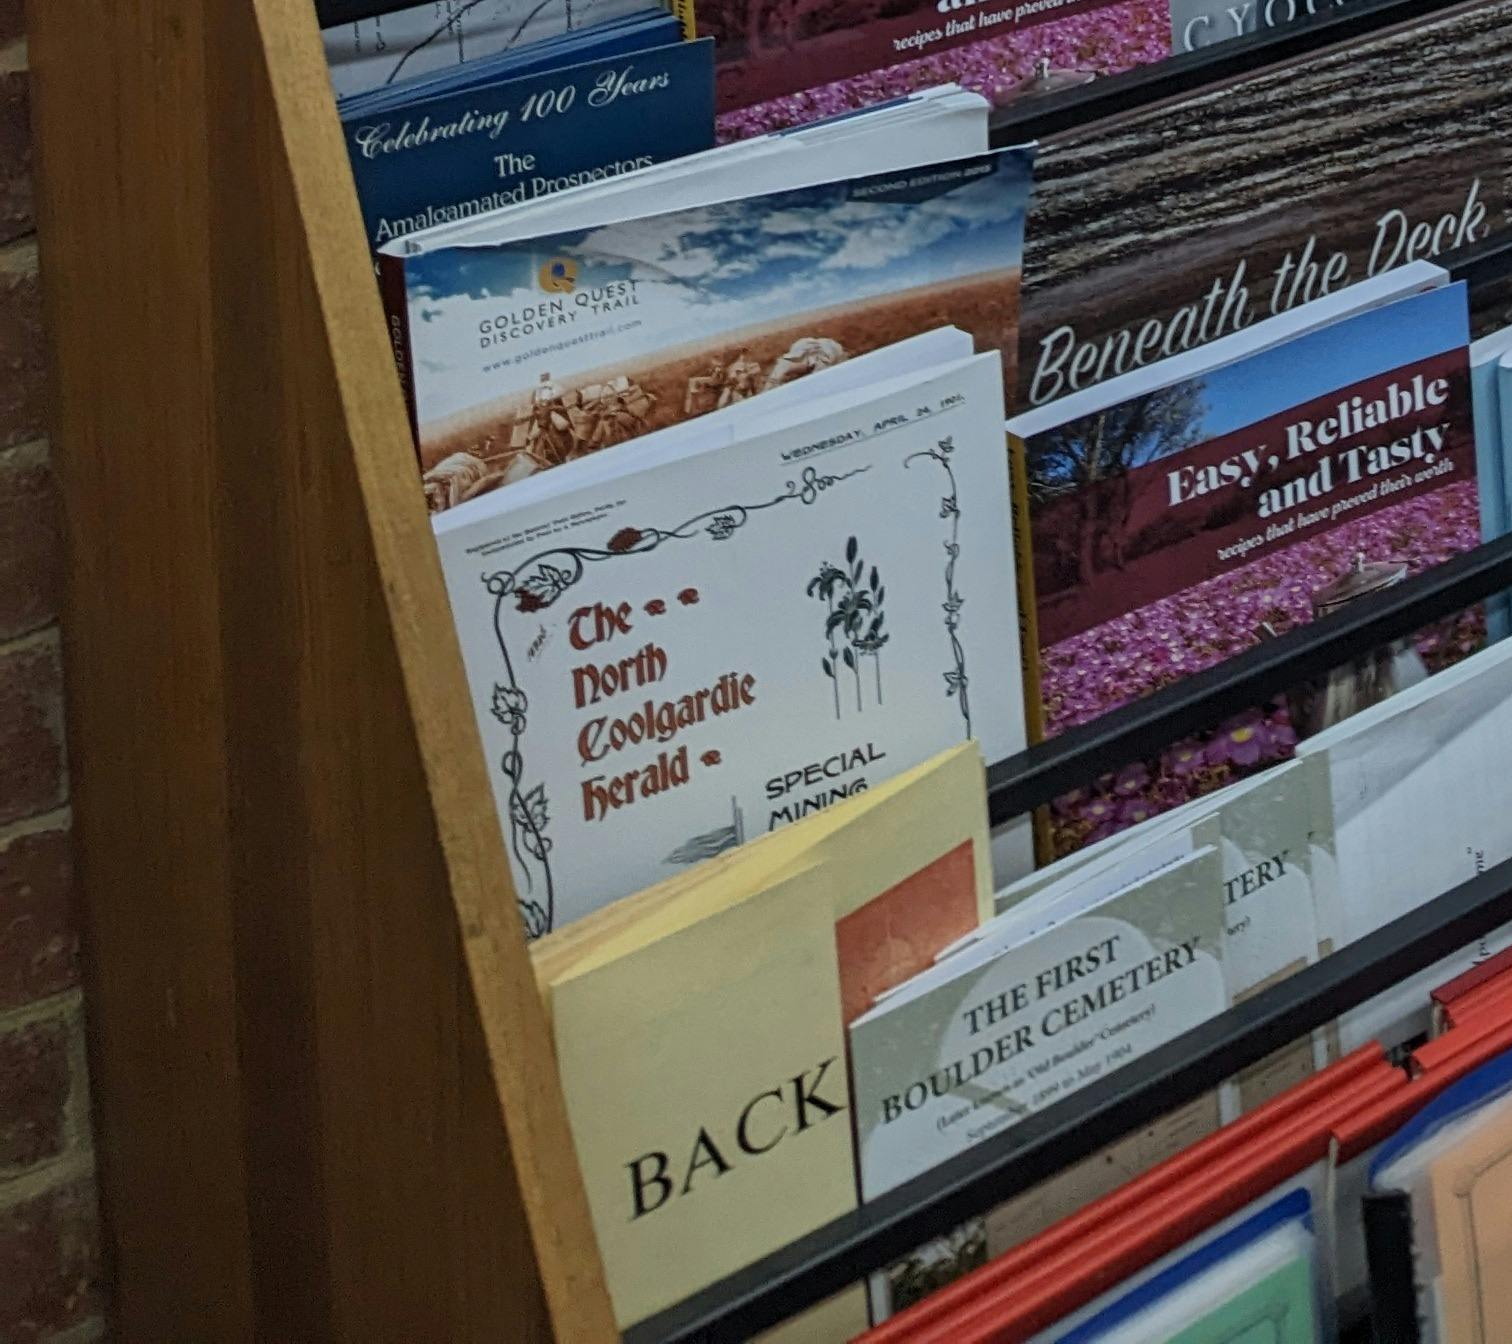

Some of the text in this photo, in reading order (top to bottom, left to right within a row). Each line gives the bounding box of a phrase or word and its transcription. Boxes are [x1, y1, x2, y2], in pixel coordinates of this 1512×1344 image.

[493, 151, 536, 180] The
[478, 279, 639, 335] GOLDEN QUEST
[479, 293, 639, 348] DISCOVERY TRAIL
[1028, 177, 1491, 407] Beneath the Deck
[482, 317, 643, 373] www.goldenquesttrail.com
[1166, 372, 1450, 507] Easy, Reliable
[1257, 418, 1451, 518] and Tasty
[764, 743, 886, 802] SPECIAL
[881, 936, 1201, 1126] BOULDER CEMETERY
[962, 934, 1122, 1036] THE FIRST
[625, 1054, 849, 1223] BACK
